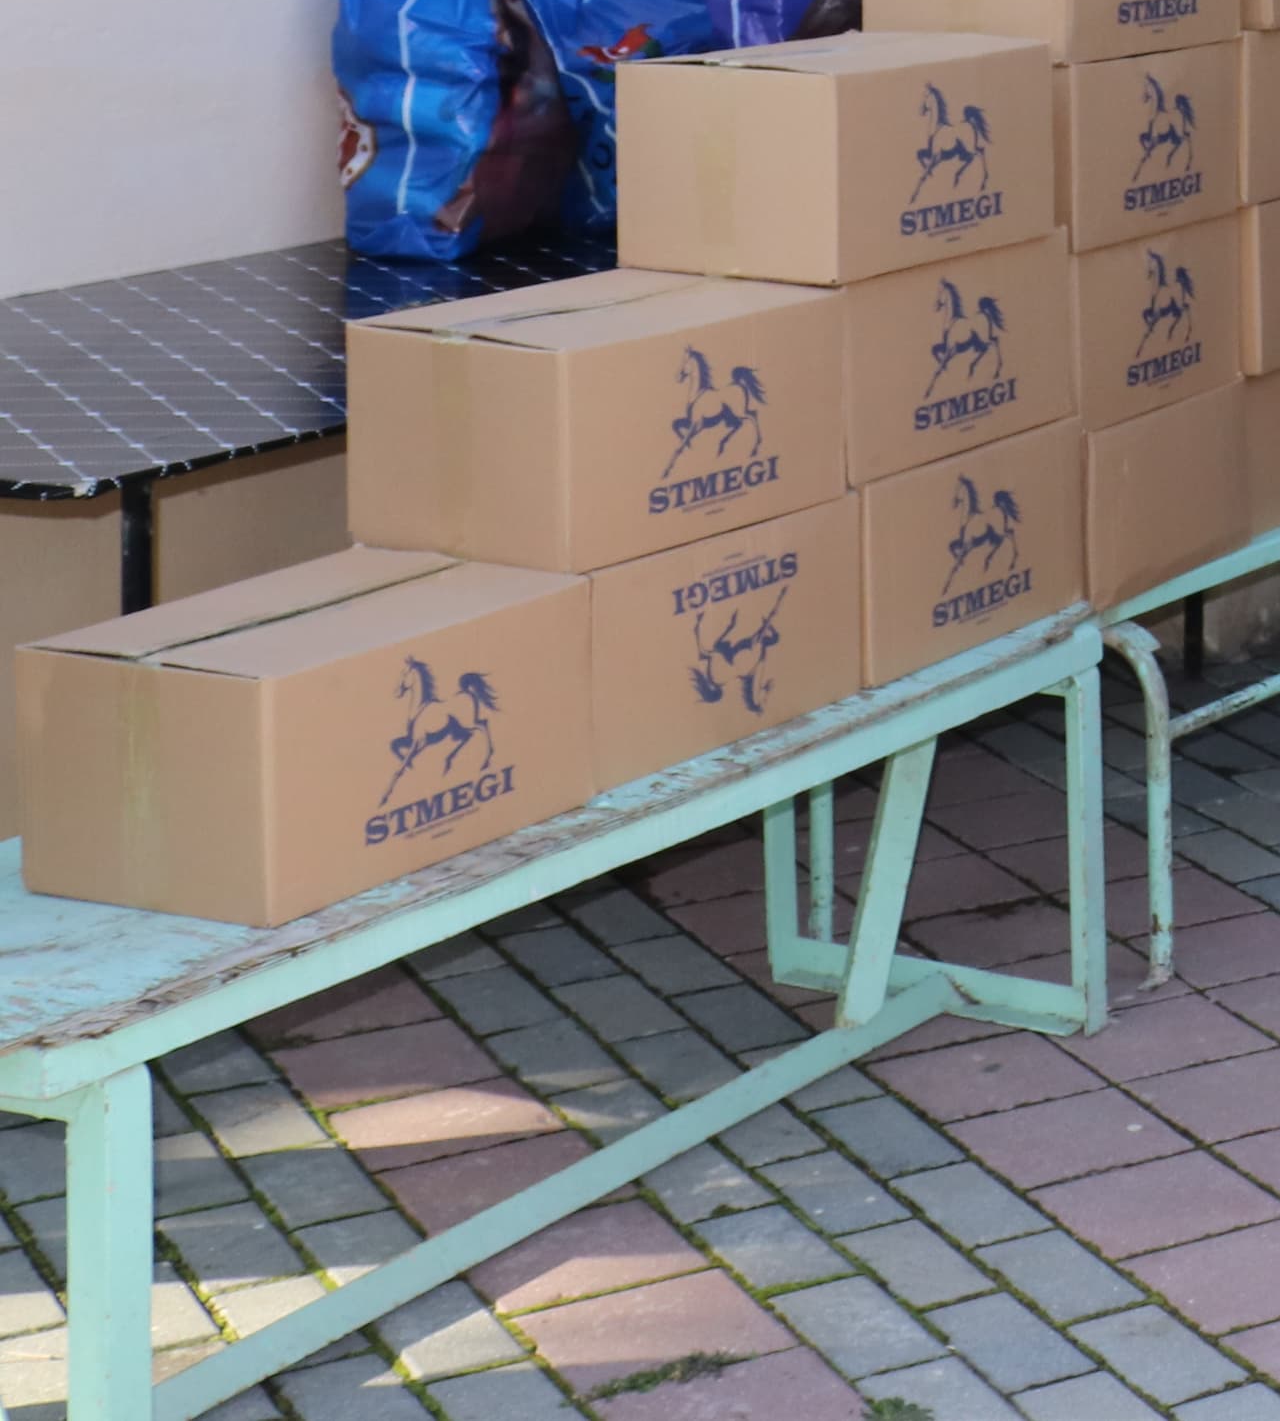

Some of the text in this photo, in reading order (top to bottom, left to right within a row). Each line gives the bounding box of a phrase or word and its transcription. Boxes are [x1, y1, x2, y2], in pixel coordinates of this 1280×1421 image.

[900, 192, 1003, 236] STMEGI
[1124, 173, 1202, 212] STMEGI
[1127, 341, 1200, 387] STMEGI
[914, 378, 1017, 430] STMEGI
[649, 455, 779, 515] STMEGI
[673, 553, 799, 615] STMEGI
[932, 569, 1033, 628] STMEGI
[364, 766, 515, 846] STMEGI
